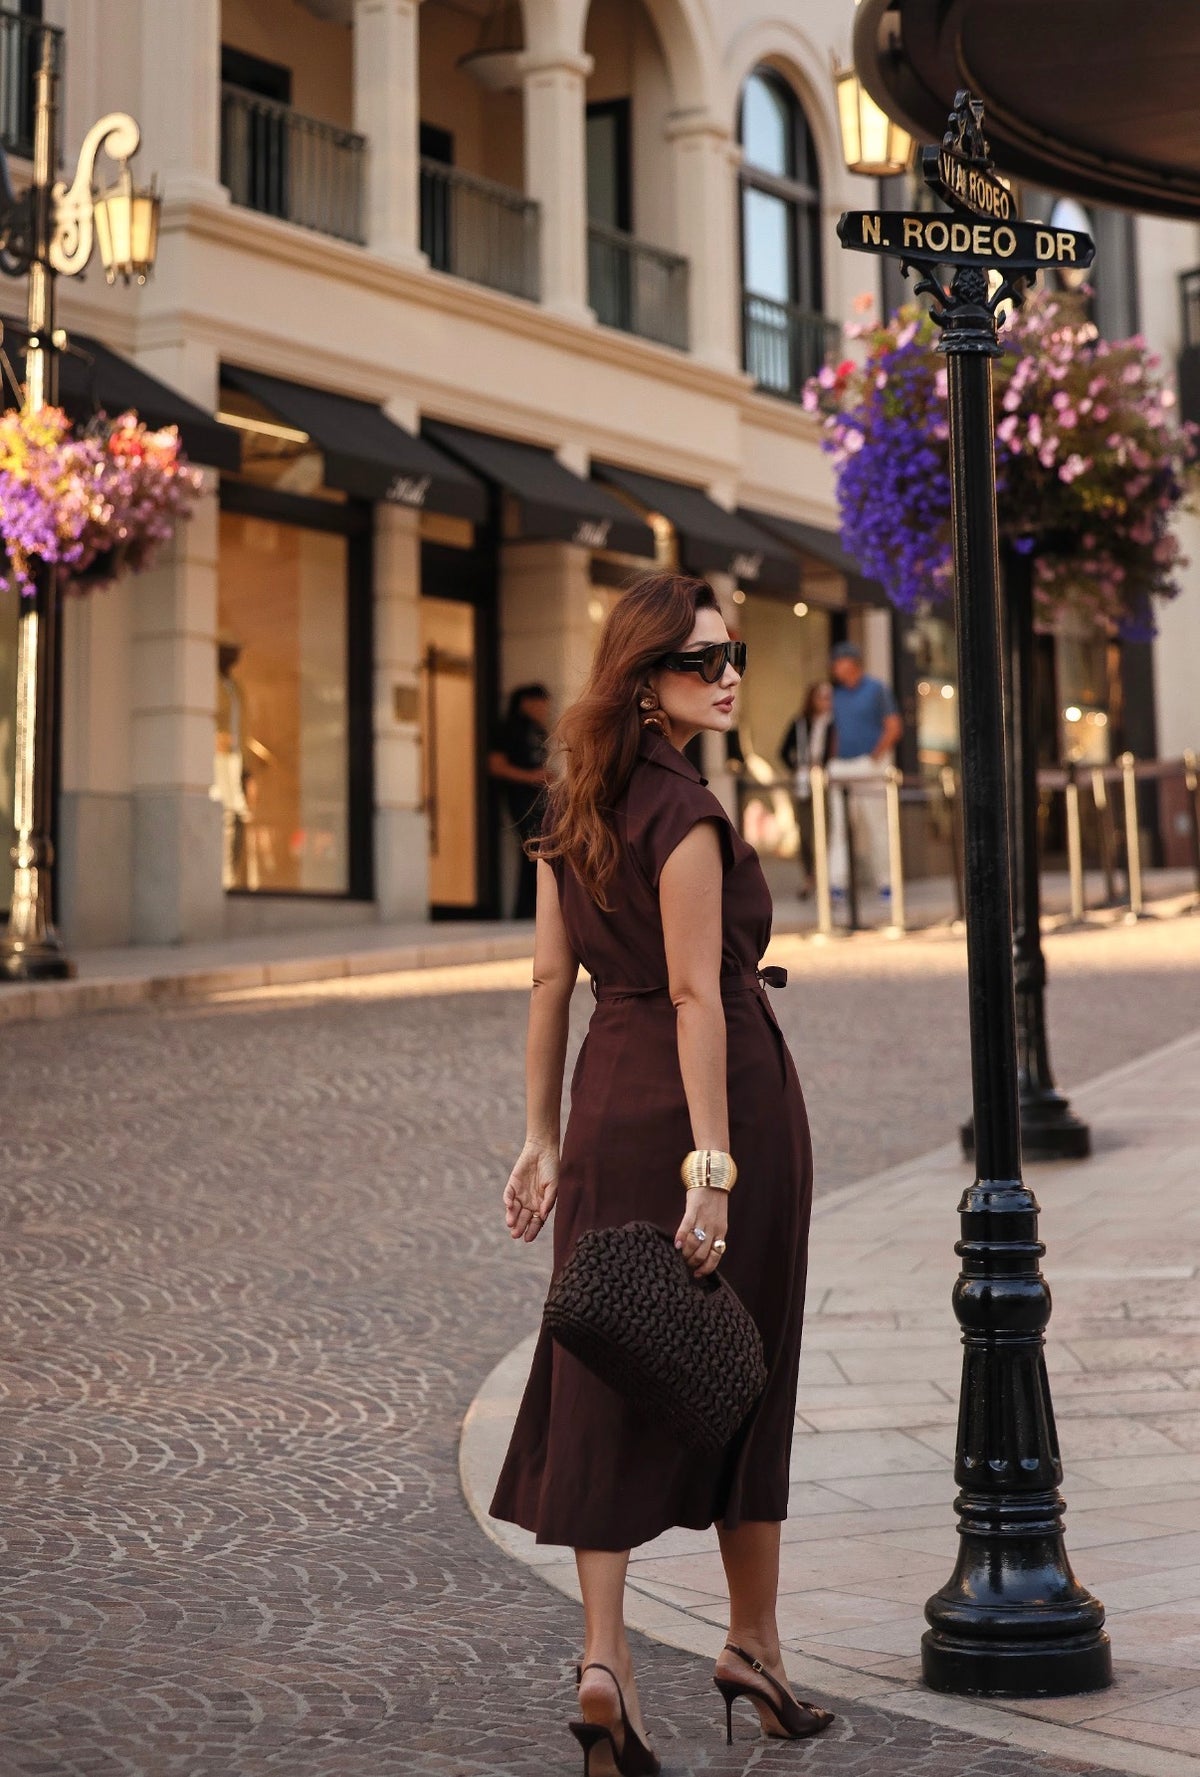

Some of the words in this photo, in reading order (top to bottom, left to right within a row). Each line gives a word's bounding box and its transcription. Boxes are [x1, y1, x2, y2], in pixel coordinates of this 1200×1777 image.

[943, 152, 966, 200] VIA
[969, 170, 1009, 220] RODEO
[861, 215, 889, 246] N.
[903, 218, 1016, 258] RODEO
[1035, 232, 1076, 262] DR
